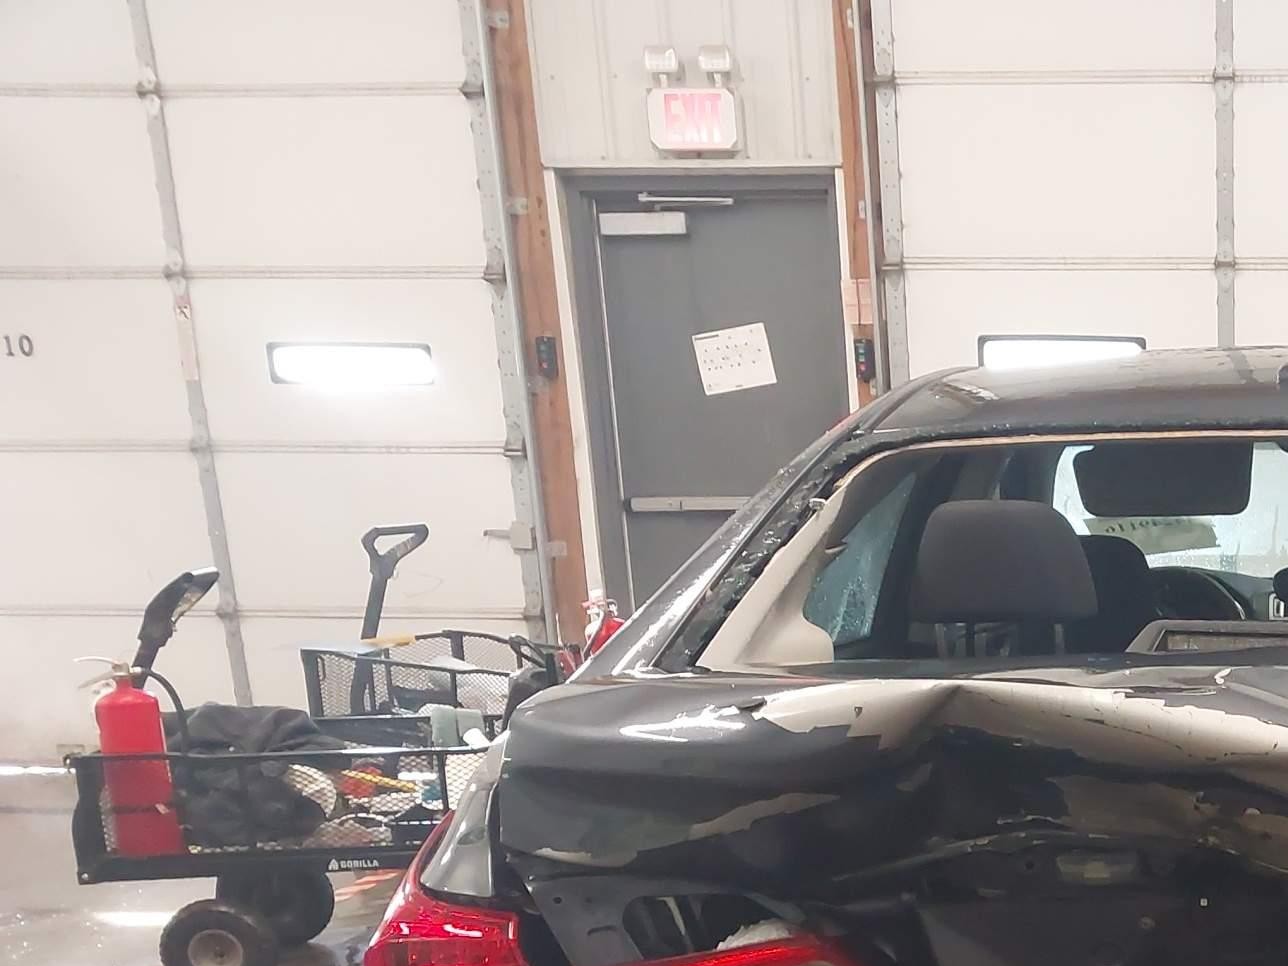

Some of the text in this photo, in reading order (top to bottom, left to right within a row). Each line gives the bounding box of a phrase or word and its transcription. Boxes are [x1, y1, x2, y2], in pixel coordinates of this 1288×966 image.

[663, 93, 721, 143] EXIT
[3, 334, 34, 358] 10
[340, 859, 379, 869] GORILLA
